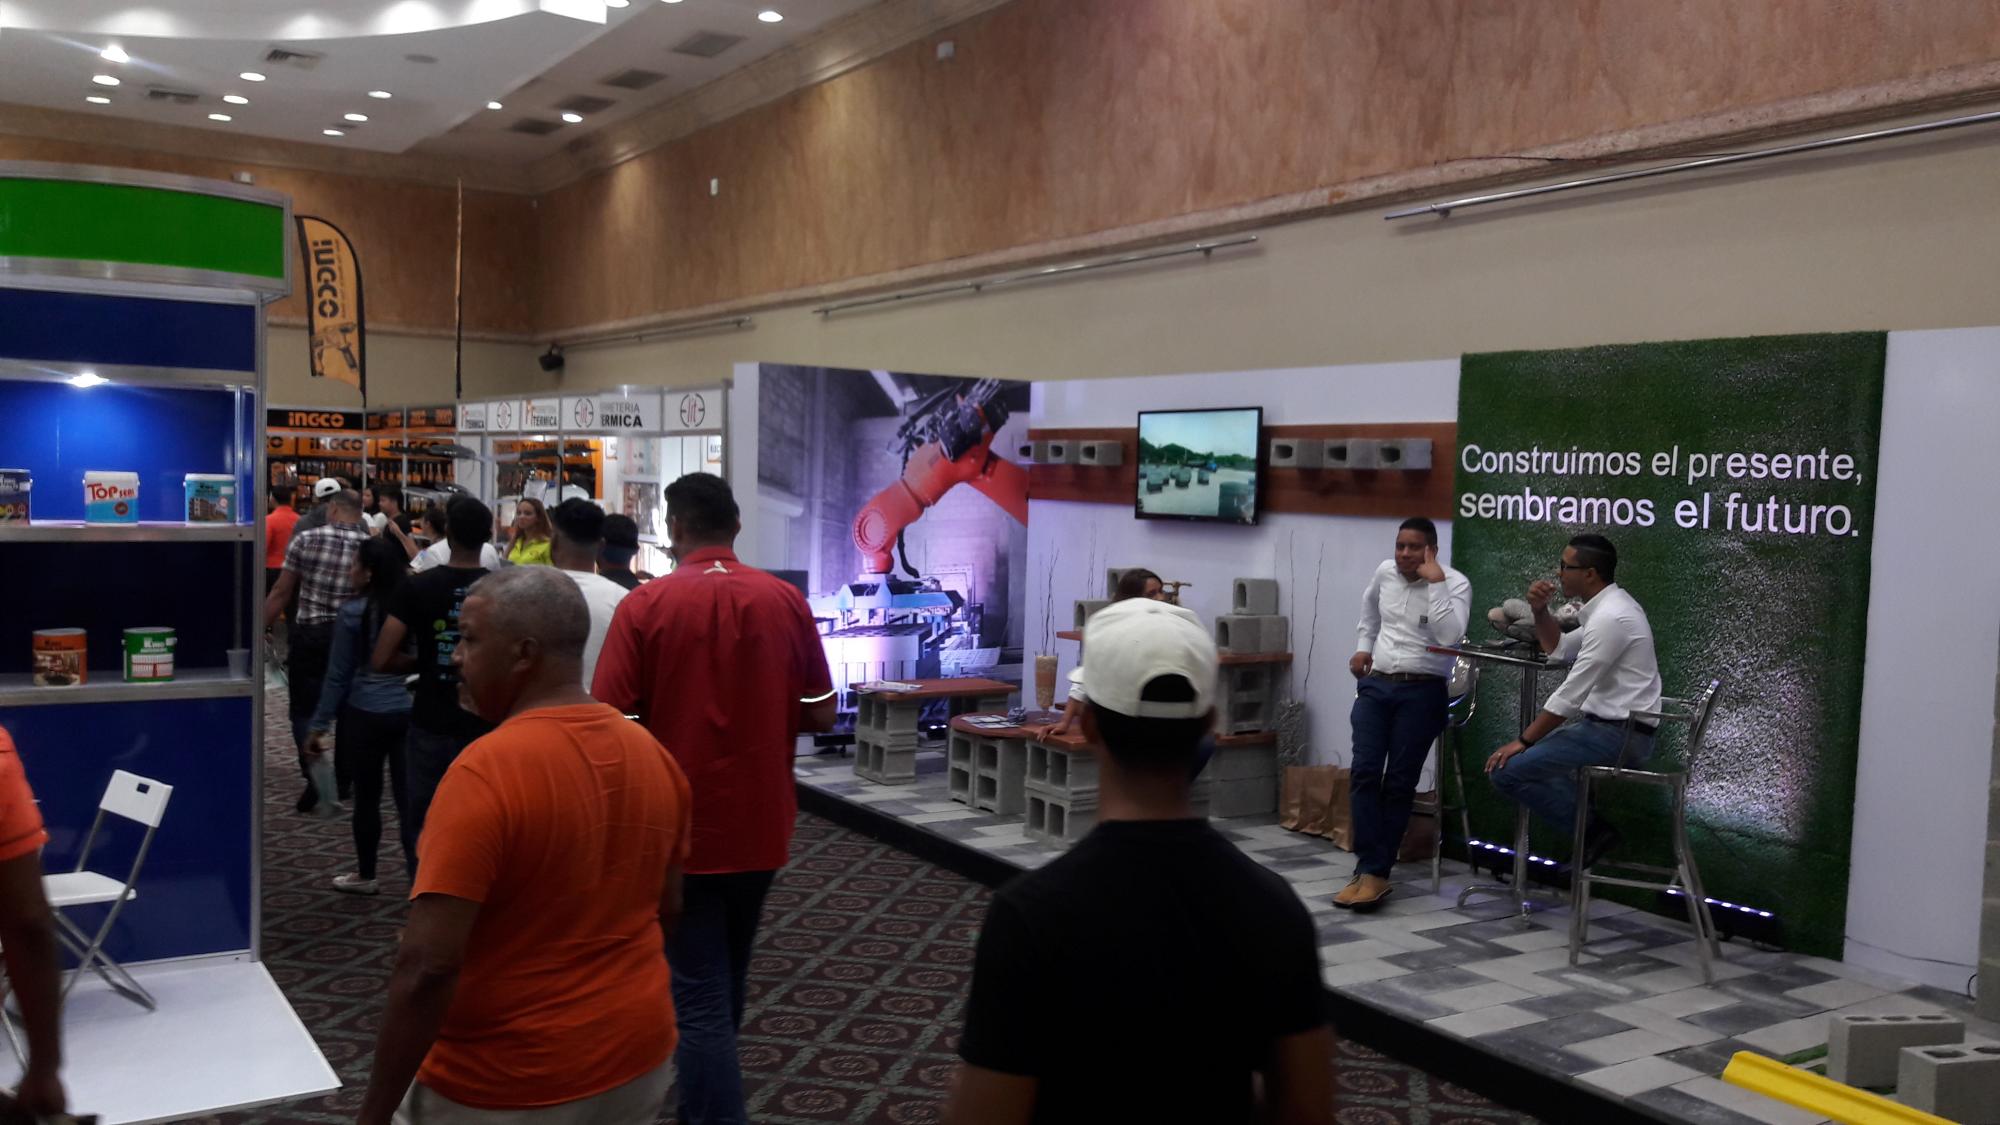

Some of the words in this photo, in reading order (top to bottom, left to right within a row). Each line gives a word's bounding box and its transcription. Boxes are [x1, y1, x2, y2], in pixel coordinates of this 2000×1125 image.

[601, 414, 643, 428] ERMICA
[1461, 443, 1642, 476] Construimos
[1651, 444, 1679, 477] el
[1688, 447, 1863, 486] presente,
[1459, 487, 1656, 527] sembramos
[1674, 491, 1710, 530] el
[1725, 492, 1860, 537] futuro.
